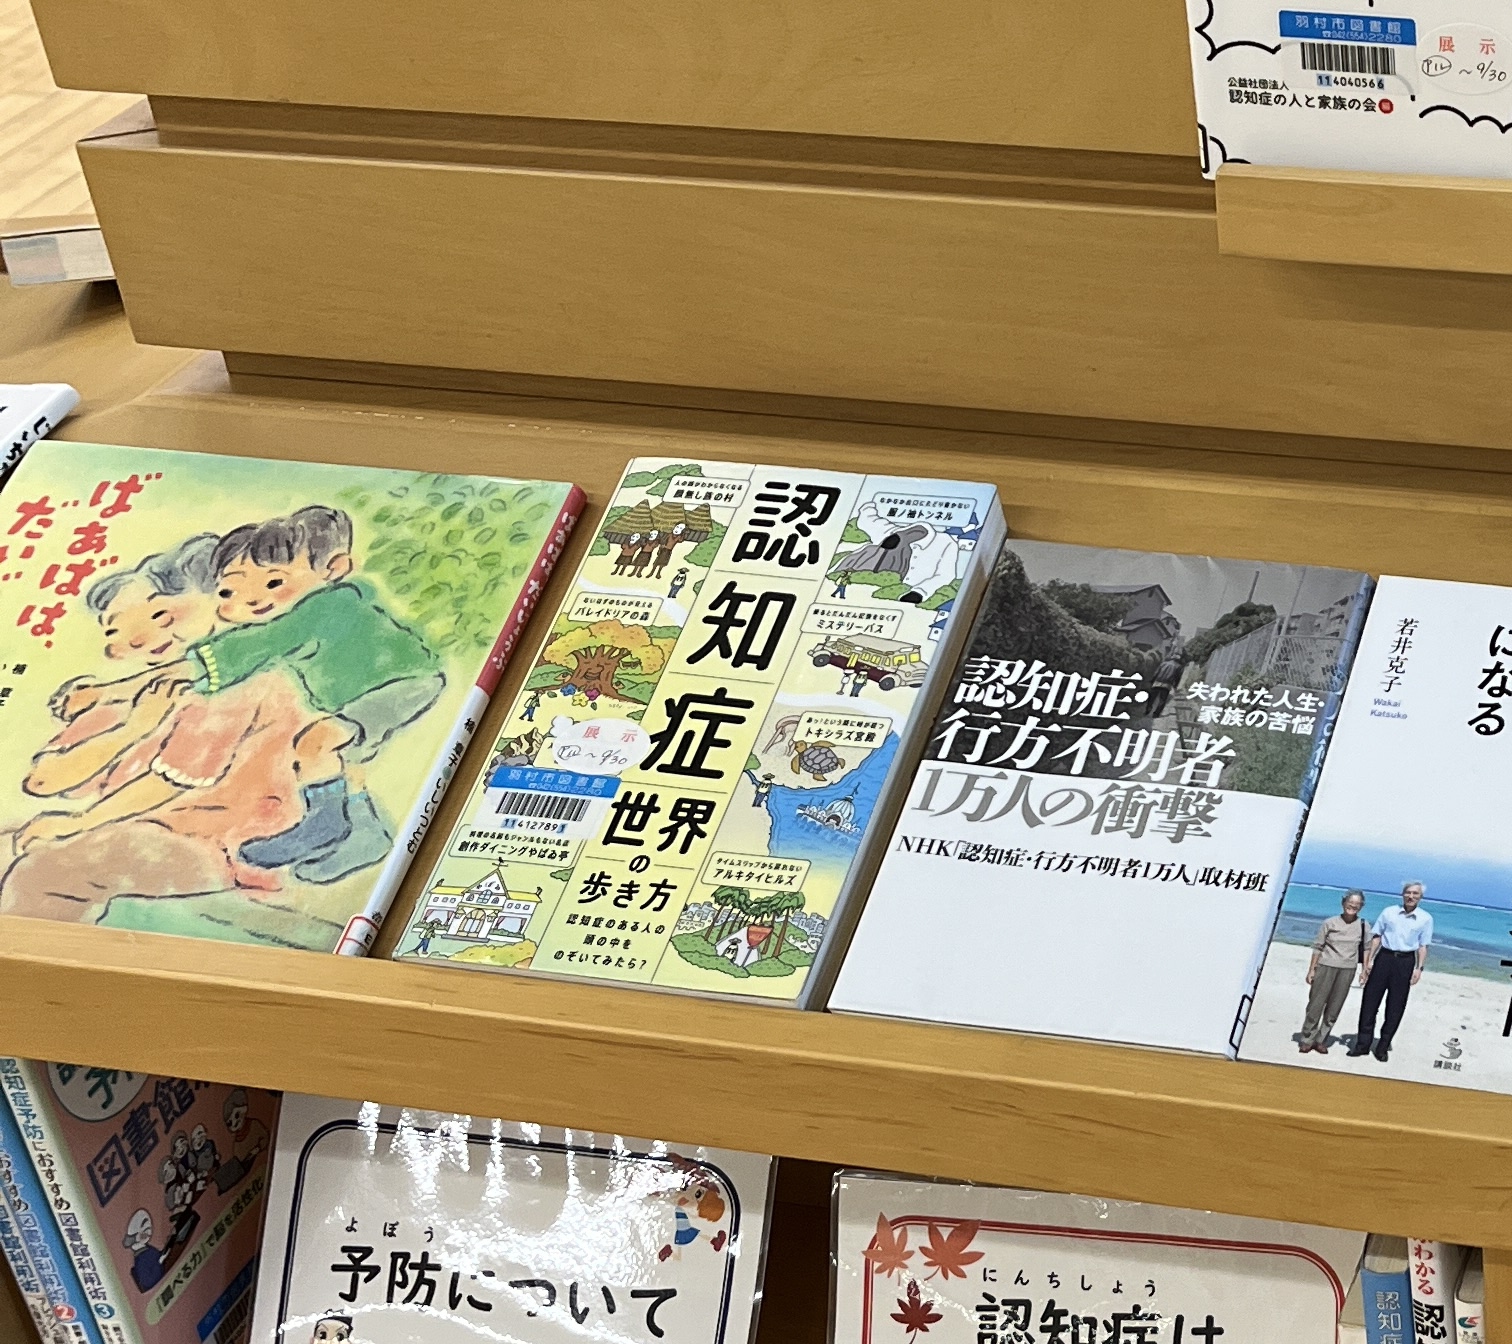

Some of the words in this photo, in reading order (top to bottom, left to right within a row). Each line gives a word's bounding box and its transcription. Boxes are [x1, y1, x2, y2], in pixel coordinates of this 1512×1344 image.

[1229, 90, 1377, 113] 認知症の人と家族の会
[644, 479, 839, 781] 認知症
[1379, 617, 1420, 694] 若井克子
[1197, 705, 1316, 737] 家族の苦悩
[933, 708, 1237, 789] 行方不明者
[602, 791, 716, 855] 世界
[911, 764, 1225, 845] 1万人の衝撃
[627, 853, 652, 873] の
[578, 870, 678, 912] 歩き方
[565, 913, 666, 935] 認知症のある人の
[330, 1245, 679, 1340] 予防について
[982, 1265, 1159, 1297] にんちしょう
